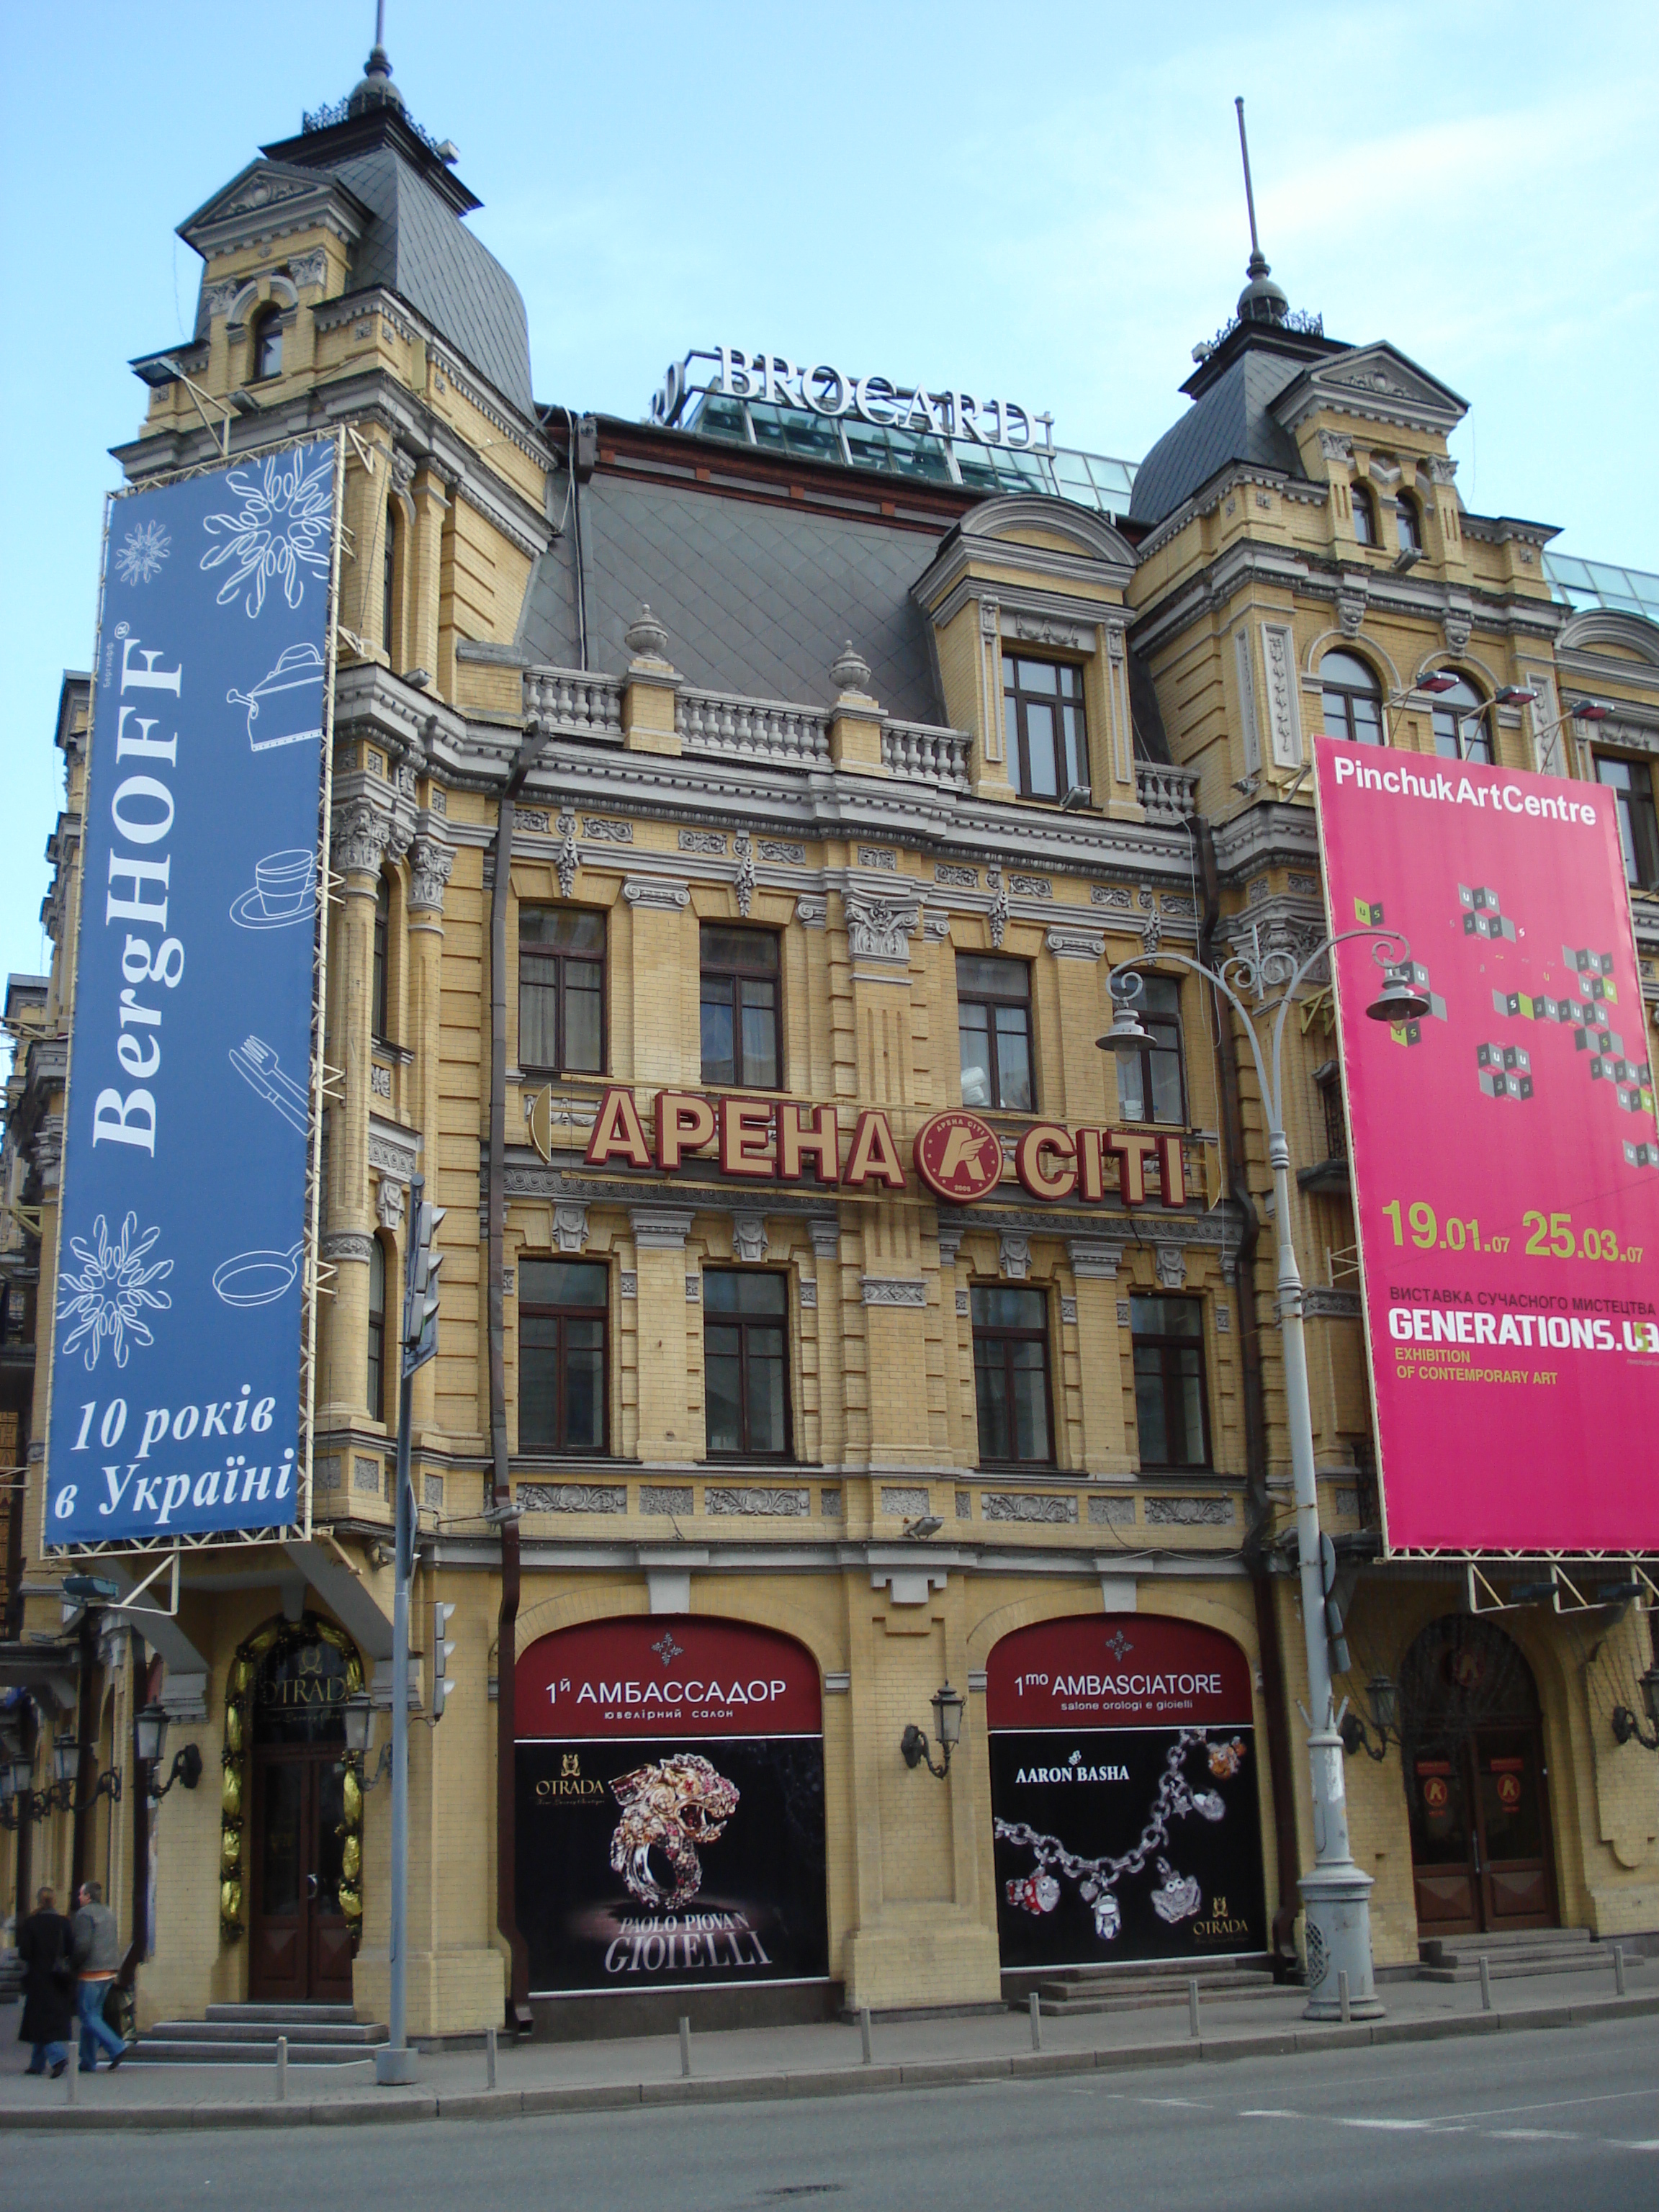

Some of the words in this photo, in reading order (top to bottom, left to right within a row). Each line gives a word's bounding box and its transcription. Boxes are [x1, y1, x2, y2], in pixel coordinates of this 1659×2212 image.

[715, 346, 1037, 451] BROCARD
[1334, 756, 1596, 826] PinchukArtCentre
[936, 1118, 964, 1133] АРЕНА
[584, 1086, 907, 1190] АРЕНА
[1015, 1121, 1187, 1210] СІТІ
[1382, 1200, 1511, 1253] 19.01.07
[1522, 1210, 1644, 1264] 25.03.07
[1390, 1286, 1474, 1305] ВИСТАВКА
[1478, 1292, 1568, 1310] СУЧАСНОГО
[1572, 1297, 1656, 1316] МИСТЕЦТВА
[1394, 1346, 1471, 1363] EXHIBITION
[1397, 1365, 1416, 1379] OF
[1419, 1366, 1529, 1384] CONTEMPORARY
[1532, 1371, 1558, 1385] ART
[71, 1398, 128, 1451] 10
[134, 1384, 276, 1459] років
[55, 1484, 78, 1519] в
[99, 1448, 295, 1525] Україні
[261, 1677, 348, 1704] OTRAD
[577, 1680, 787, 1705] АМБАССАДОР
[1052, 1674, 1223, 1696] AMBASCIATORE
[603, 1708, 682, 1721] ювелірний
[691, 1709, 734, 1719] салон
[1061, 1701, 1100, 1711] salone
[1102, 1700, 1143, 1712] orologi
[1156, 1699, 1193, 1711] gioielli
[1015, 1767, 1073, 1784] AARON
[1076, 1765, 1130, 1782] BASHA
[536, 1779, 604, 1796] OTRADA
[619, 1915, 678, 1935] PAOLO
[684, 1912, 750, 1931] PIOVAN
[1193, 1919, 1249, 1936] OTRADA
[603, 1930, 773, 1973] GIOIELLI
